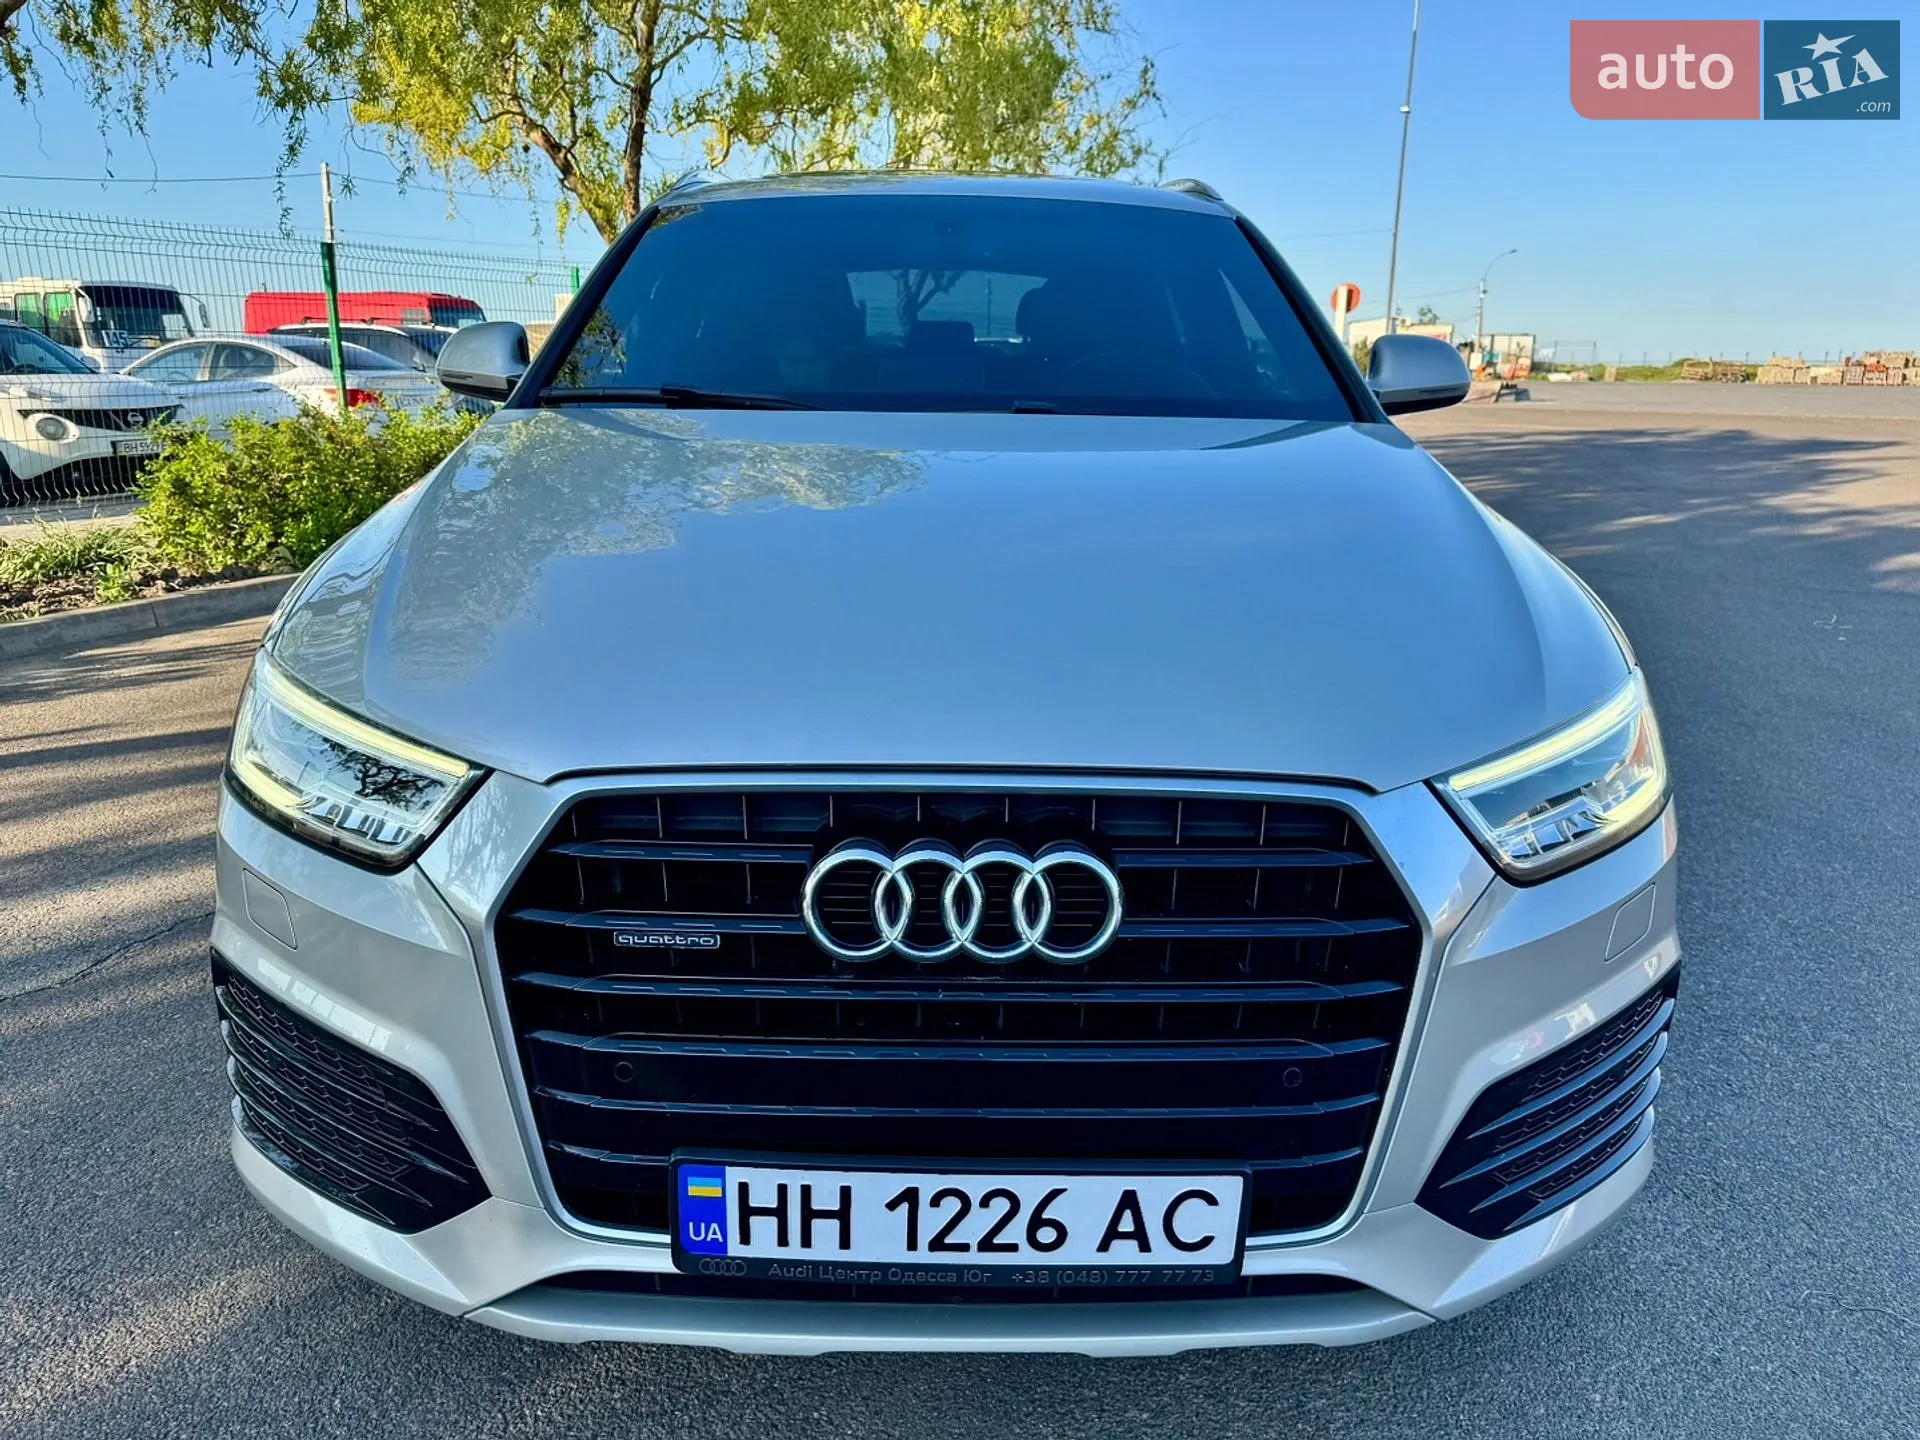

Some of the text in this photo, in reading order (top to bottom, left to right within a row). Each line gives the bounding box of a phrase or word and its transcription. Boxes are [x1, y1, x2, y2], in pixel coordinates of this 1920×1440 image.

[618, 934, 715, 945] quattro
[737, 1181, 1219, 1254] HH 1226 AC
[688, 1221, 723, 1243] UA
[768, 1263, 1215, 1285] Audi Центр Одесса Юг +38 (048) 777 77 73
